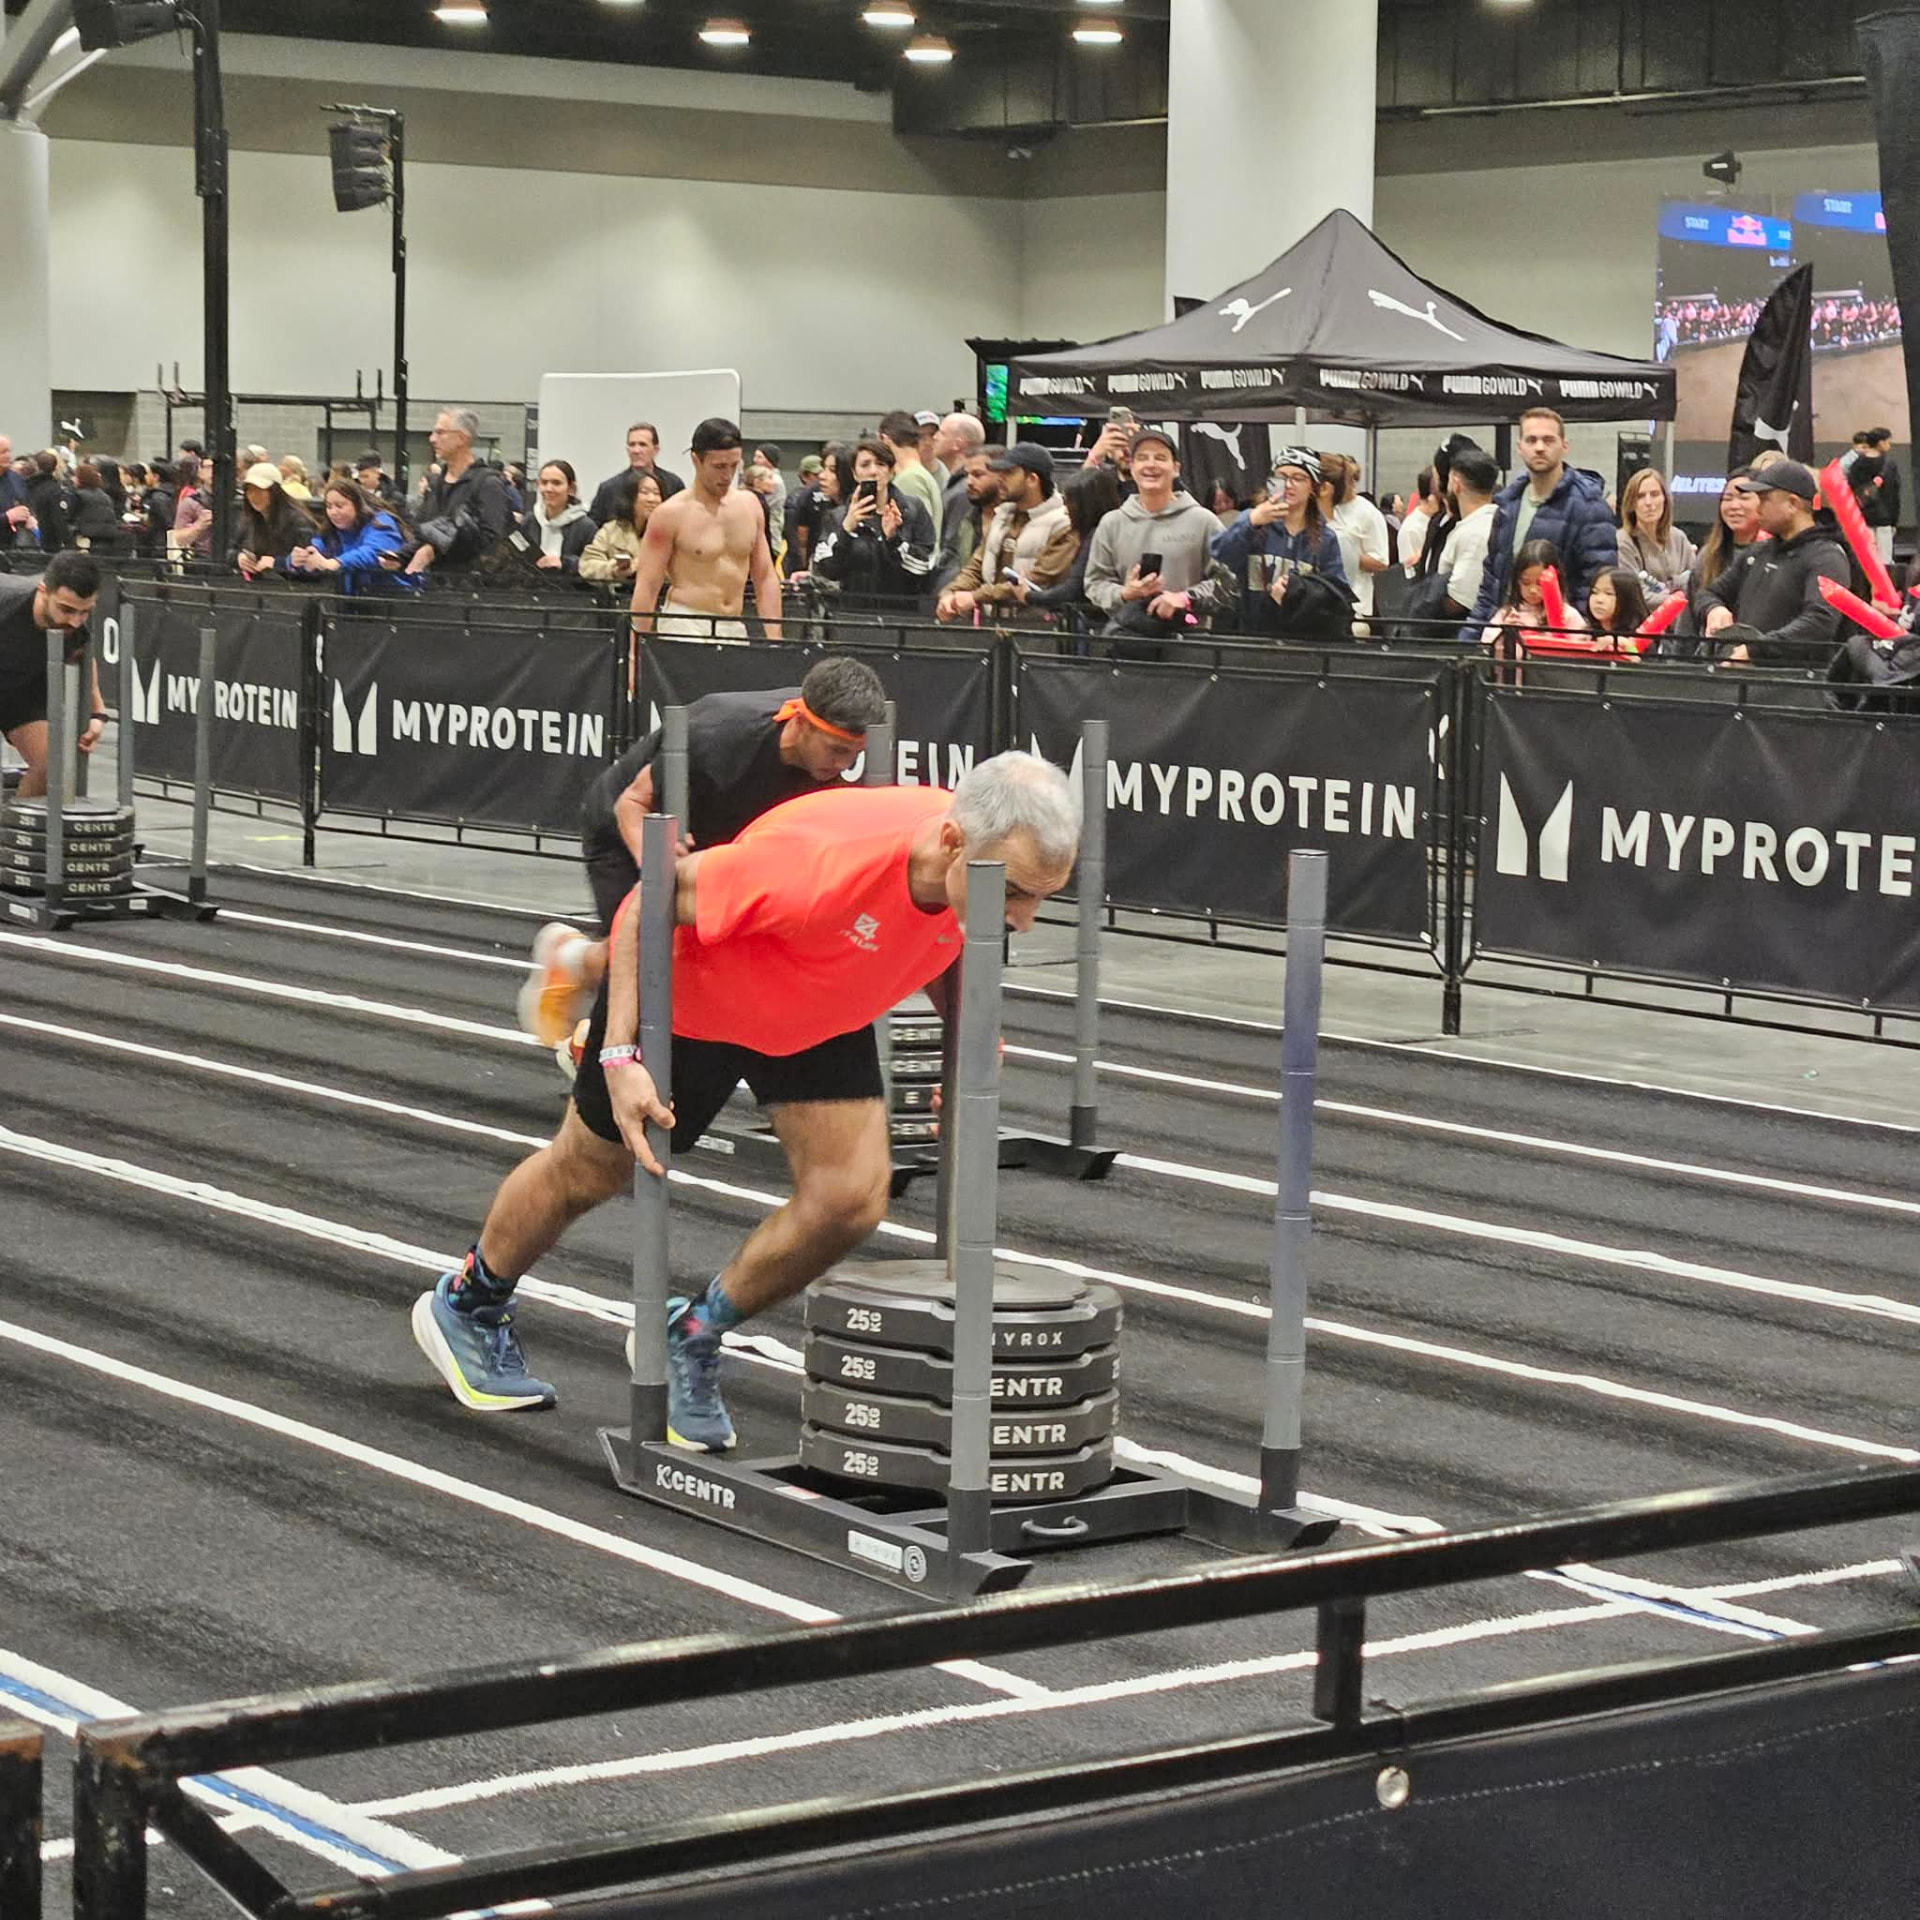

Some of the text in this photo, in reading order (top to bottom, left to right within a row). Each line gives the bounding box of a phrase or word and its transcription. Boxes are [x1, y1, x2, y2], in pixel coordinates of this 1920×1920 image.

[167, 674, 298, 730] MYROTEIN
[392, 698, 604, 758] MYPROTEIN
[1106, 759, 1416, 840] MYPROTEIN
[74, 823, 116, 833] CENTR
[69, 843, 112, 853] CENTR
[1600, 806, 1916, 897] MYPROTE
[66, 863, 110, 873] CENTR
[68, 883, 111, 893] CENTR
[889, 1028, 943, 1041] CENT
[889, 1060, 943, 1073] CENT
[990, 1377, 1063, 1397] ENTR
[992, 1424, 1066, 1445] ENTR
[991, 1472, 1065, 1492] ENTR
